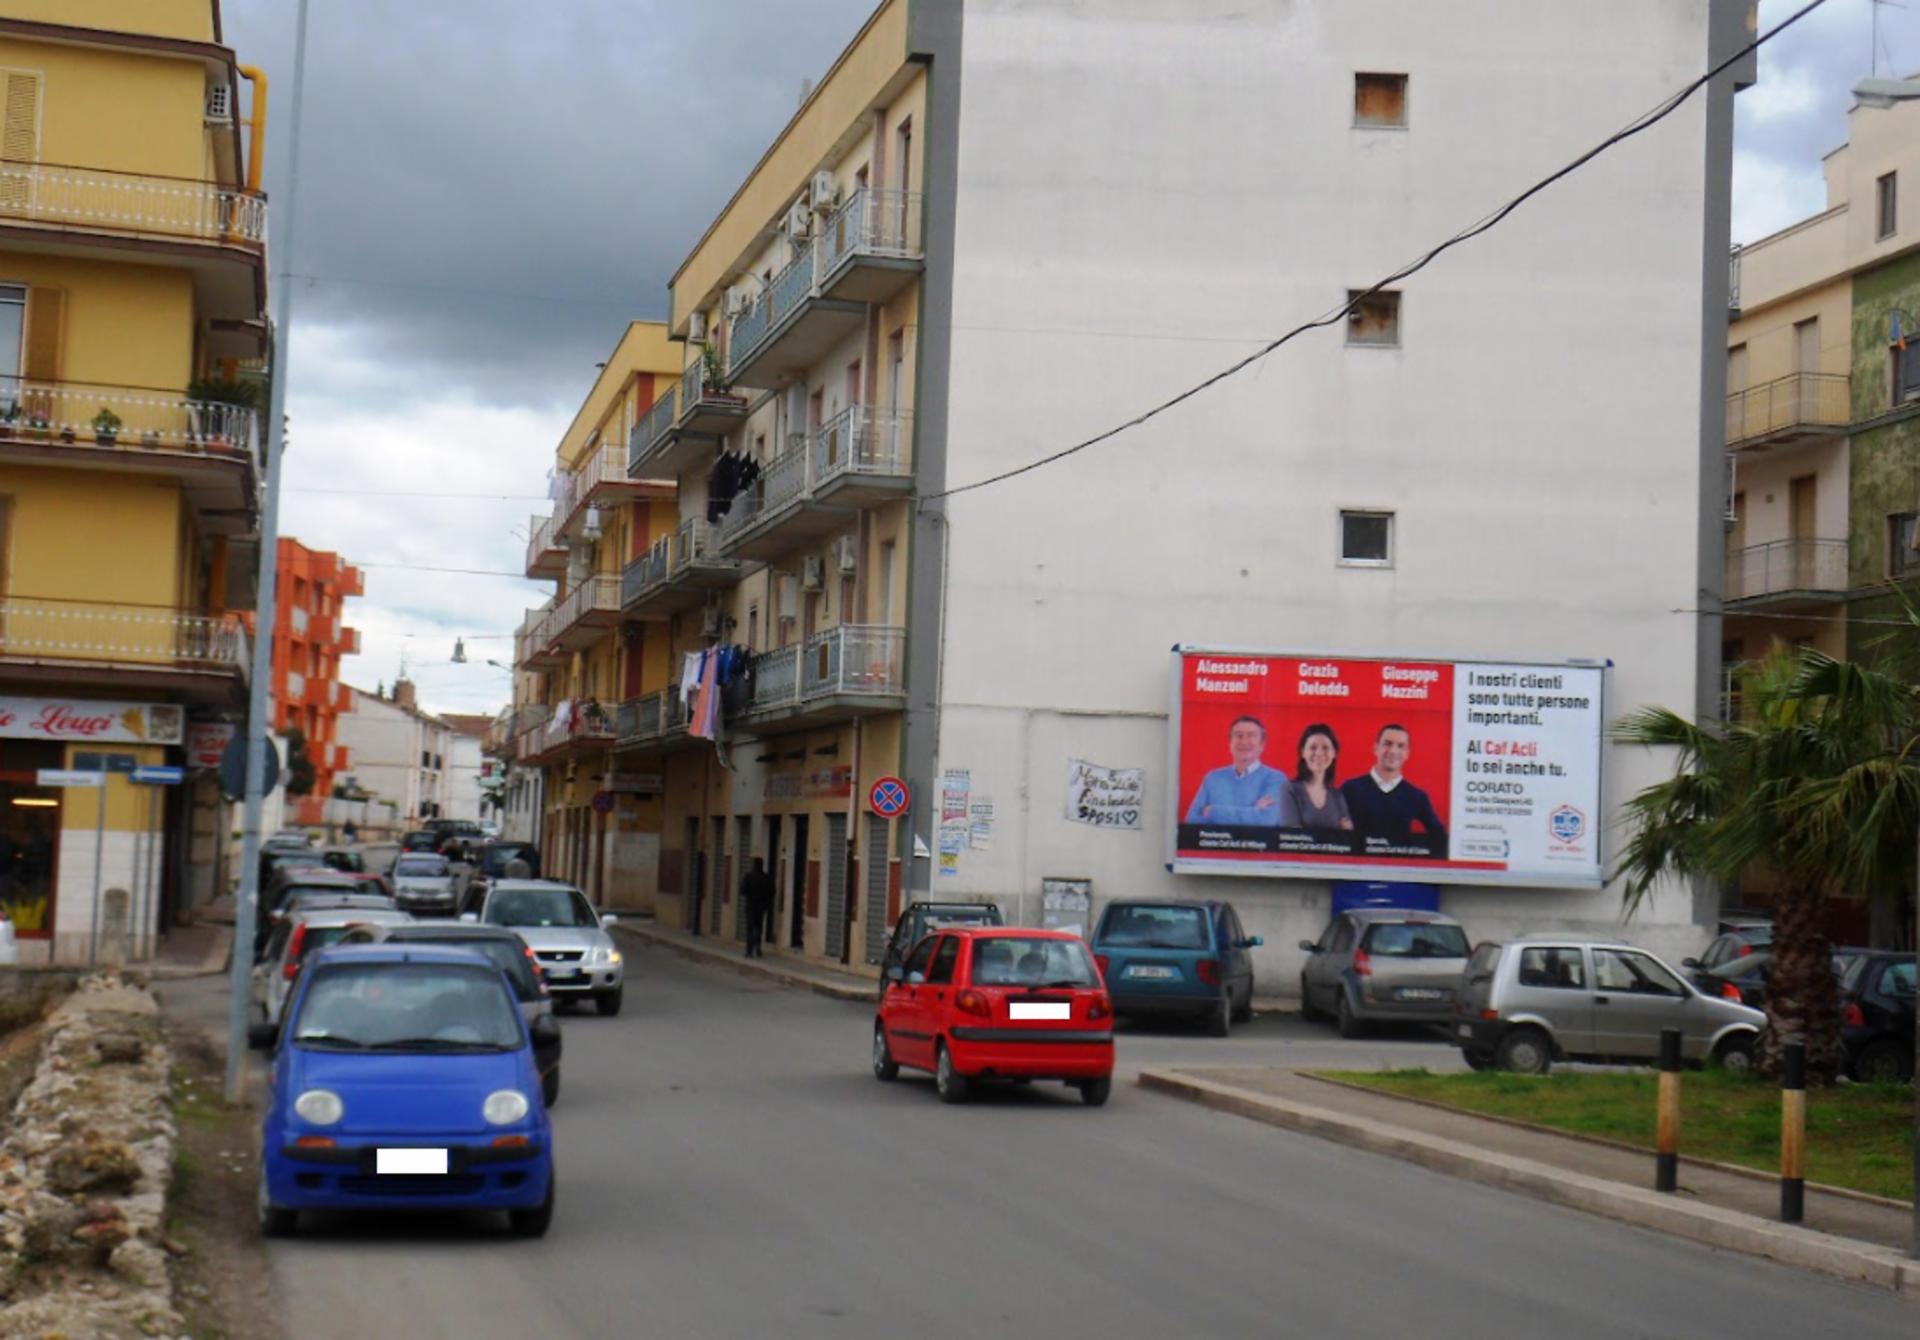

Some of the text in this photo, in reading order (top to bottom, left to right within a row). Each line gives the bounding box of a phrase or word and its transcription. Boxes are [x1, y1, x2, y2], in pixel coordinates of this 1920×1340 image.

[1197, 660, 1268, 676] Alessandro
[1299, 663, 1338, 678] Grazia
[1382, 666, 1439, 683] Giuseppe
[1197, 678, 1248, 693] Manzoni
[1299, 681, 1349, 696] Deledda
[1477, 672, 1517, 687] nostri
[1520, 674, 1563, 689] clienti
[1382, 684, 1428, 699] Mazzini
[1468, 693, 1589, 710] sono tutte persone
[1468, 708, 1543, 726] importanti.
[1467, 740, 1537, 756] Al Caf Acli
[1466, 759, 1567, 776] lo sei anche tu.
[1466, 781, 1523, 795] CORATO
